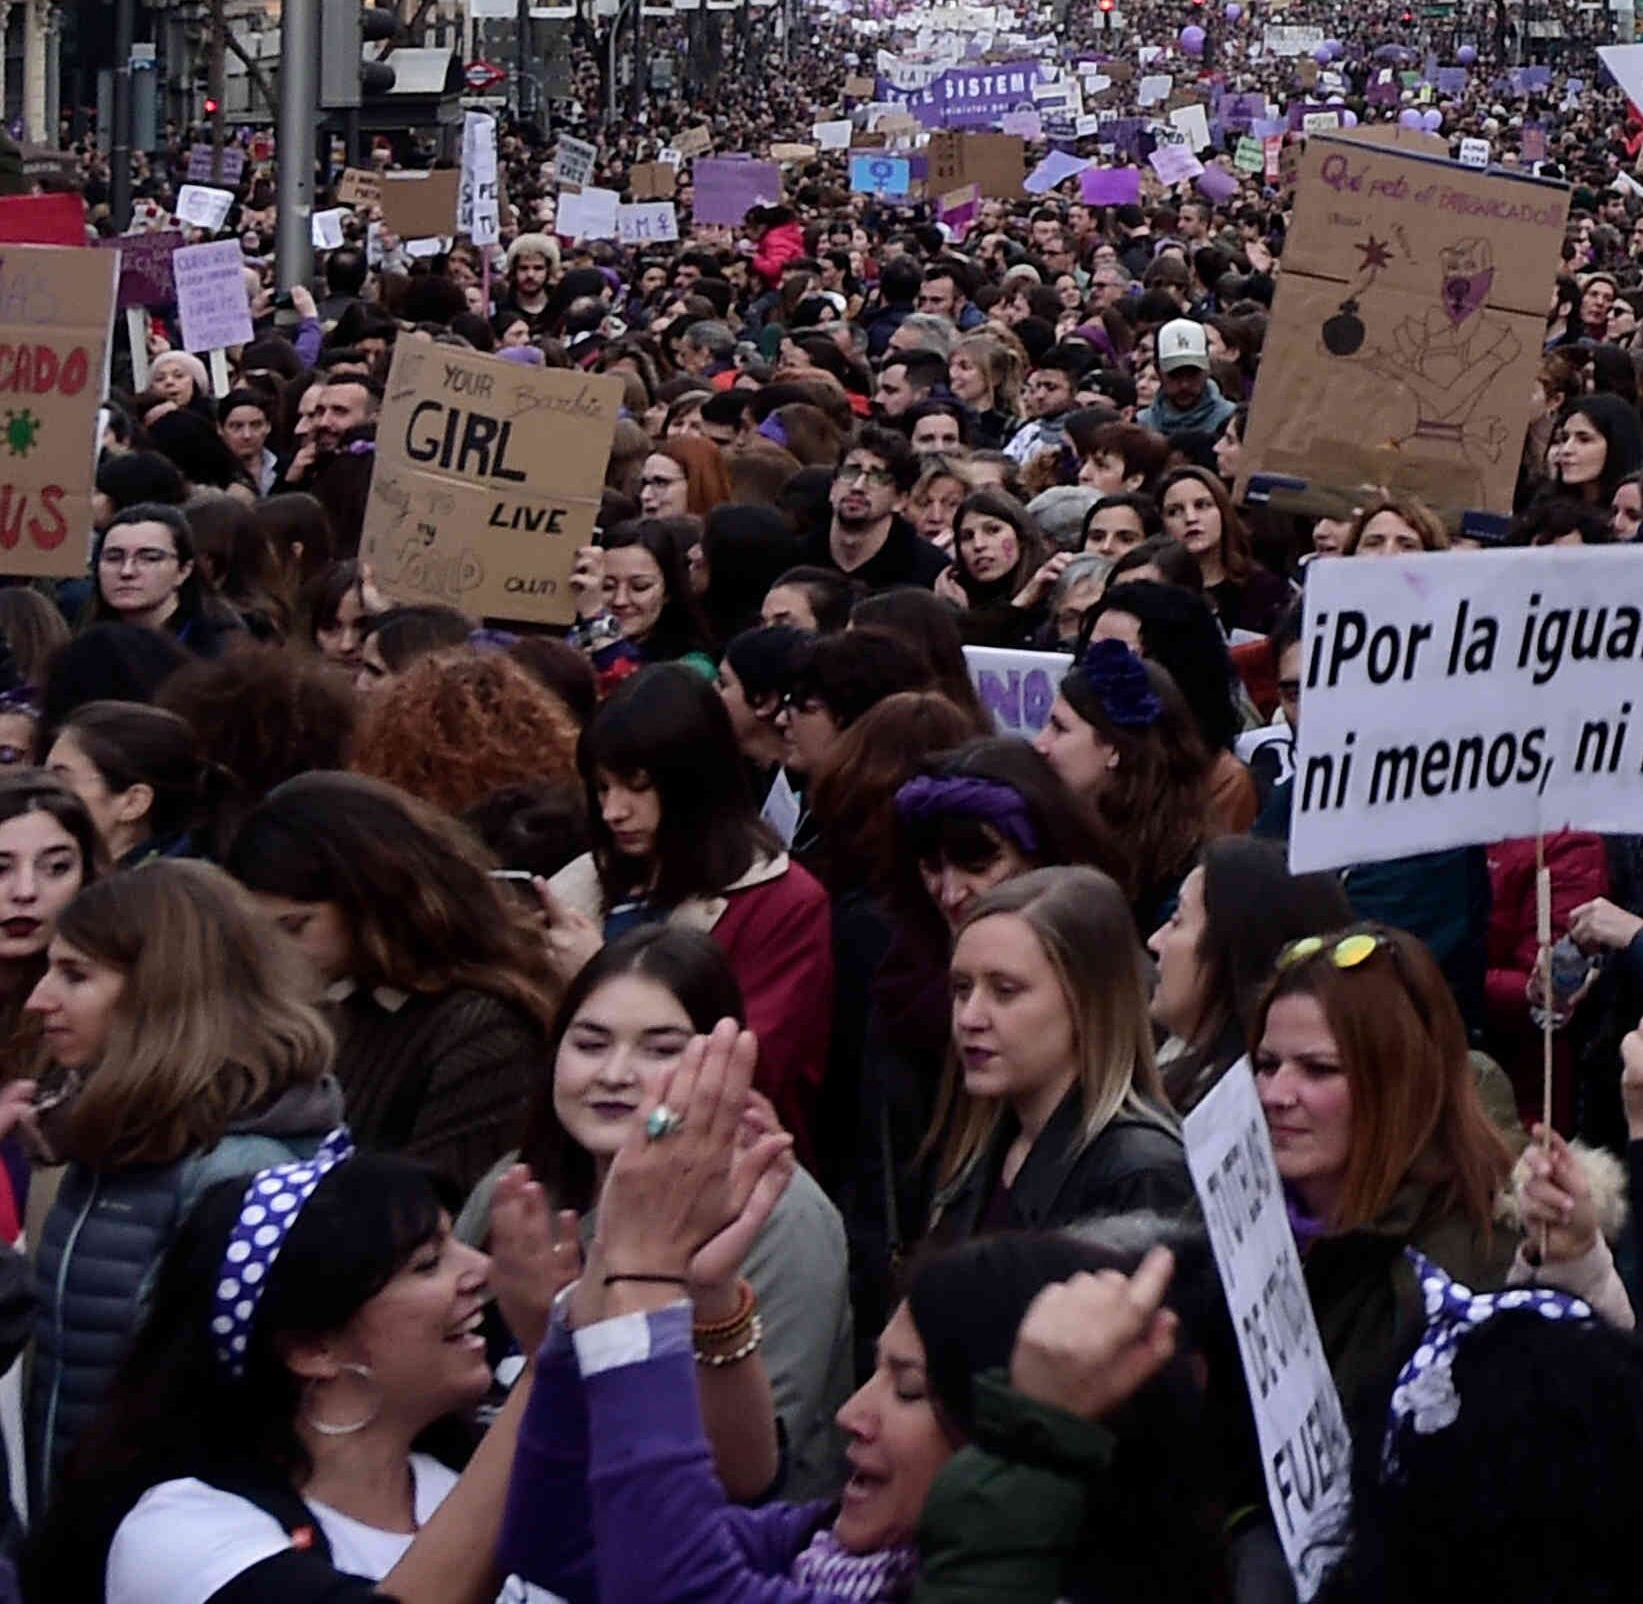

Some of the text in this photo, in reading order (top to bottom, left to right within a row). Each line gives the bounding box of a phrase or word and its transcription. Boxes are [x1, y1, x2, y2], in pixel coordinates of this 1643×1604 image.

[405, 400, 528, 483] GIRL
[488, 502, 568, 536] LIVE
[1447, 599, 1499, 676] la
[1301, 732, 1356, 812] ni
[1368, 725, 1554, 796] menos,
[1574, 702, 1632, 773] ni
